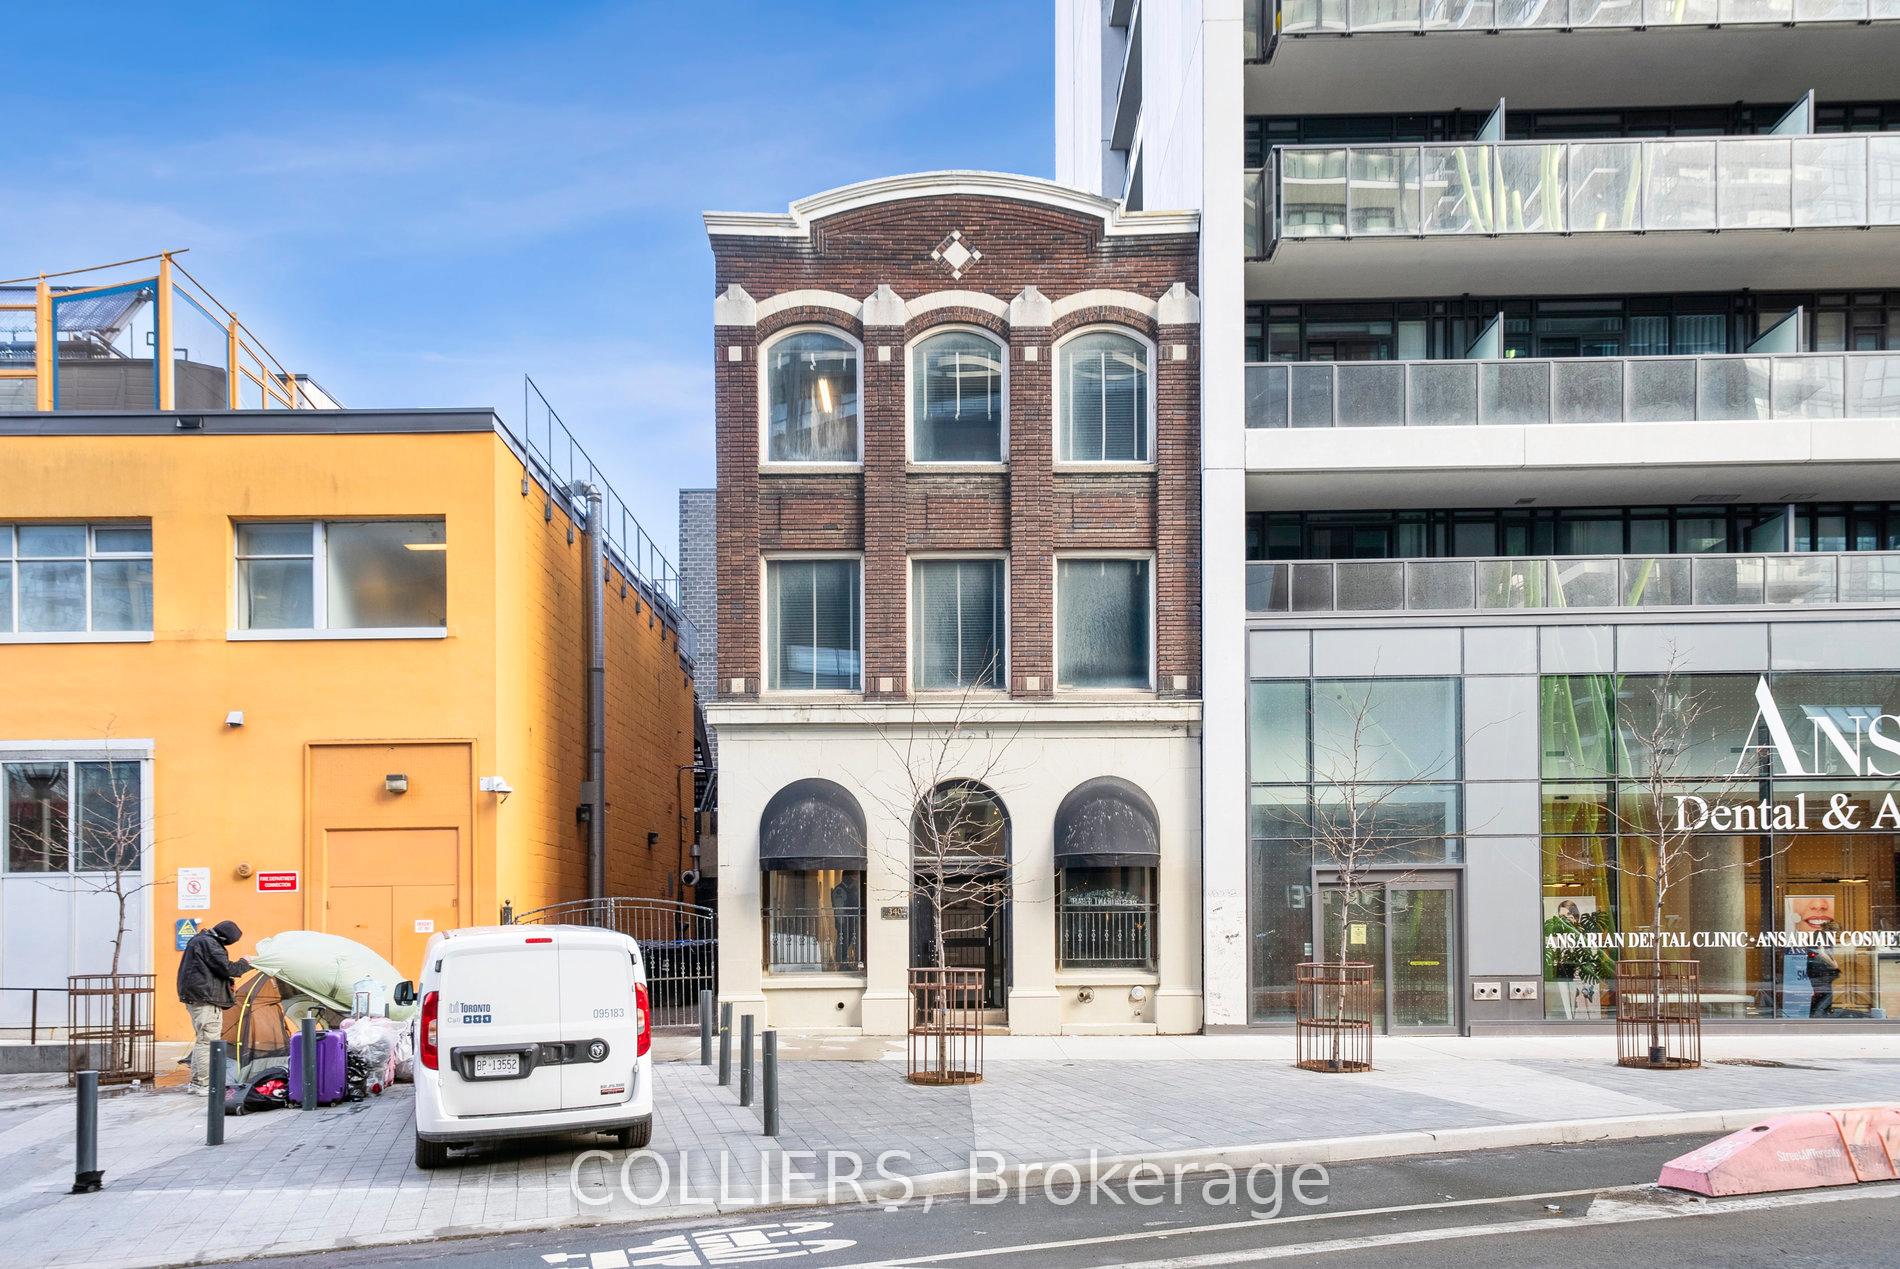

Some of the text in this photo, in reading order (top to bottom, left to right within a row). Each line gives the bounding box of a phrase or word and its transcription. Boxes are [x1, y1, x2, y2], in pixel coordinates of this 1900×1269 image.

[1673, 793, 1809, 831] Dental
[1822, 793, 1861, 830] &
[1546, 932, 1625, 949] ANSARIAN
[1692, 931, 1748, 948] CLINIC
[1756, 931, 1837, 947] ANSARIAN
[1840, 930, 1900, 947] COSME
[460, 1002, 491, 1013] TORONTO
[593, 1008, 625, 1019] 095183
